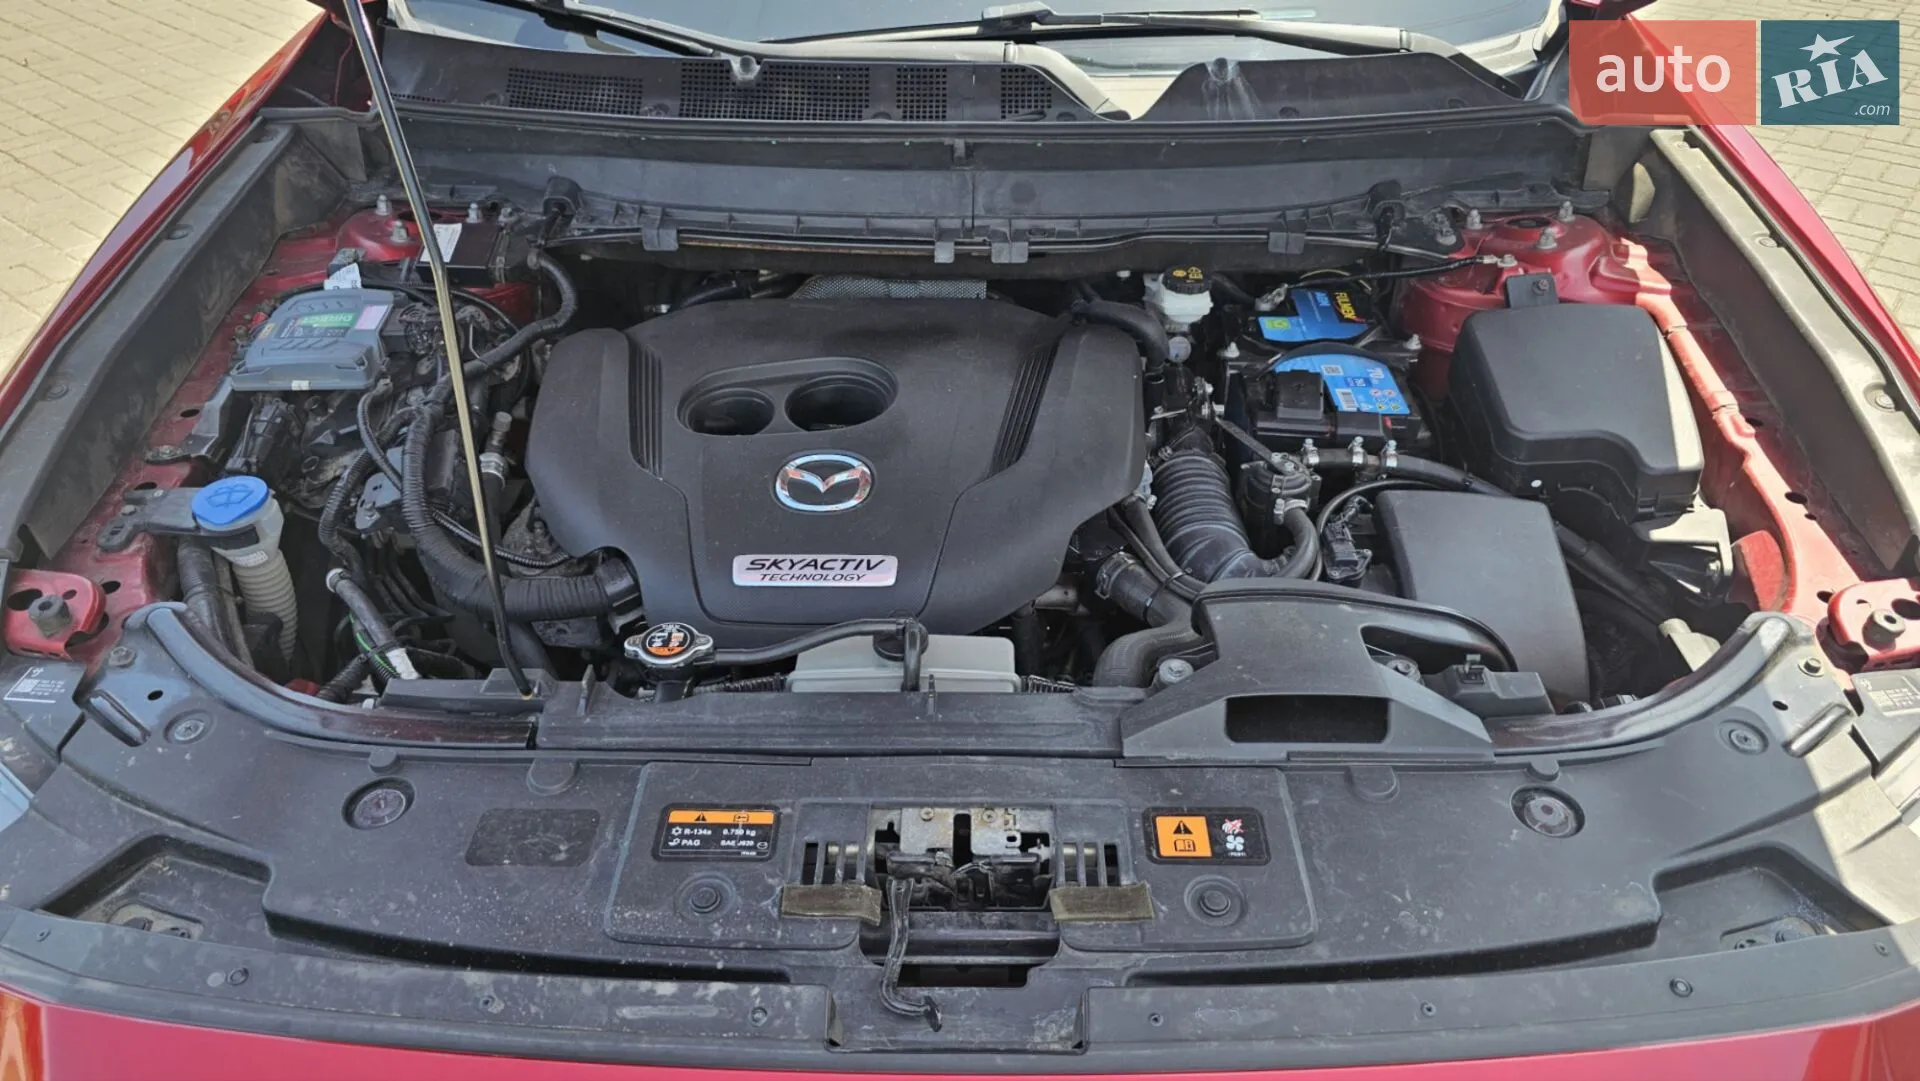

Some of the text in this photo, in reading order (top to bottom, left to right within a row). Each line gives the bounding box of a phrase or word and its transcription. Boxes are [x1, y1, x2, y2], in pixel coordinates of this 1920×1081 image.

[1334, 292, 1357, 319] FULMEN
[745, 558, 886, 571] SKYACTIV
[760, 573, 867, 582] TECHNOLOGY
[683, 828, 712, 836] R-134a
[745, 829, 757, 837] kg
[681, 839, 701, 847] PAG
